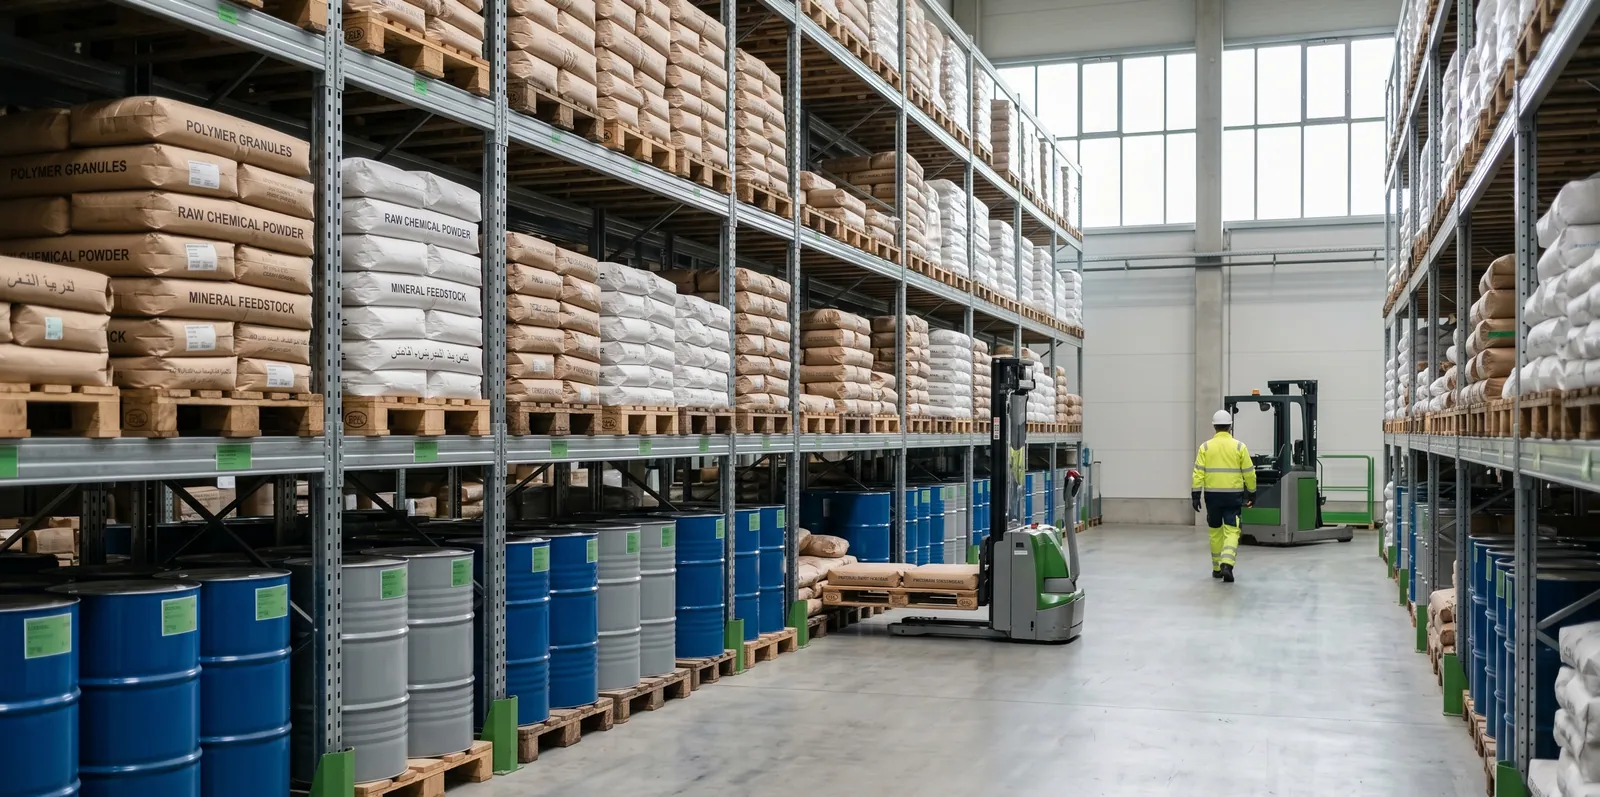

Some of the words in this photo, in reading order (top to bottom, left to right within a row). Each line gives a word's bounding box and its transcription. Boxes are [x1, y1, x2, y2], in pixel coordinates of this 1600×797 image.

[186, 119, 237, 144] POLYMER
[238, 134, 293, 158] GRANULES
[10, 164, 62, 180] POLYMER
[65, 160, 127, 176] GRANULES
[178, 206, 204, 221] RAW
[207, 211, 261, 231] CHEMICAL
[263, 221, 304, 240] POWDER
[385, 213, 403, 225] RAW
[404, 216, 441, 233] CHEMICAL
[442, 224, 471, 240] POWDER
[78, 249, 129, 262] POWDER
[189, 291, 236, 307] MINERAL
[238, 296, 295, 314] FEEDSTOCK
[391, 282, 426, 296] MINERAL
[426, 287, 467, 302] FEEDSTOCK
